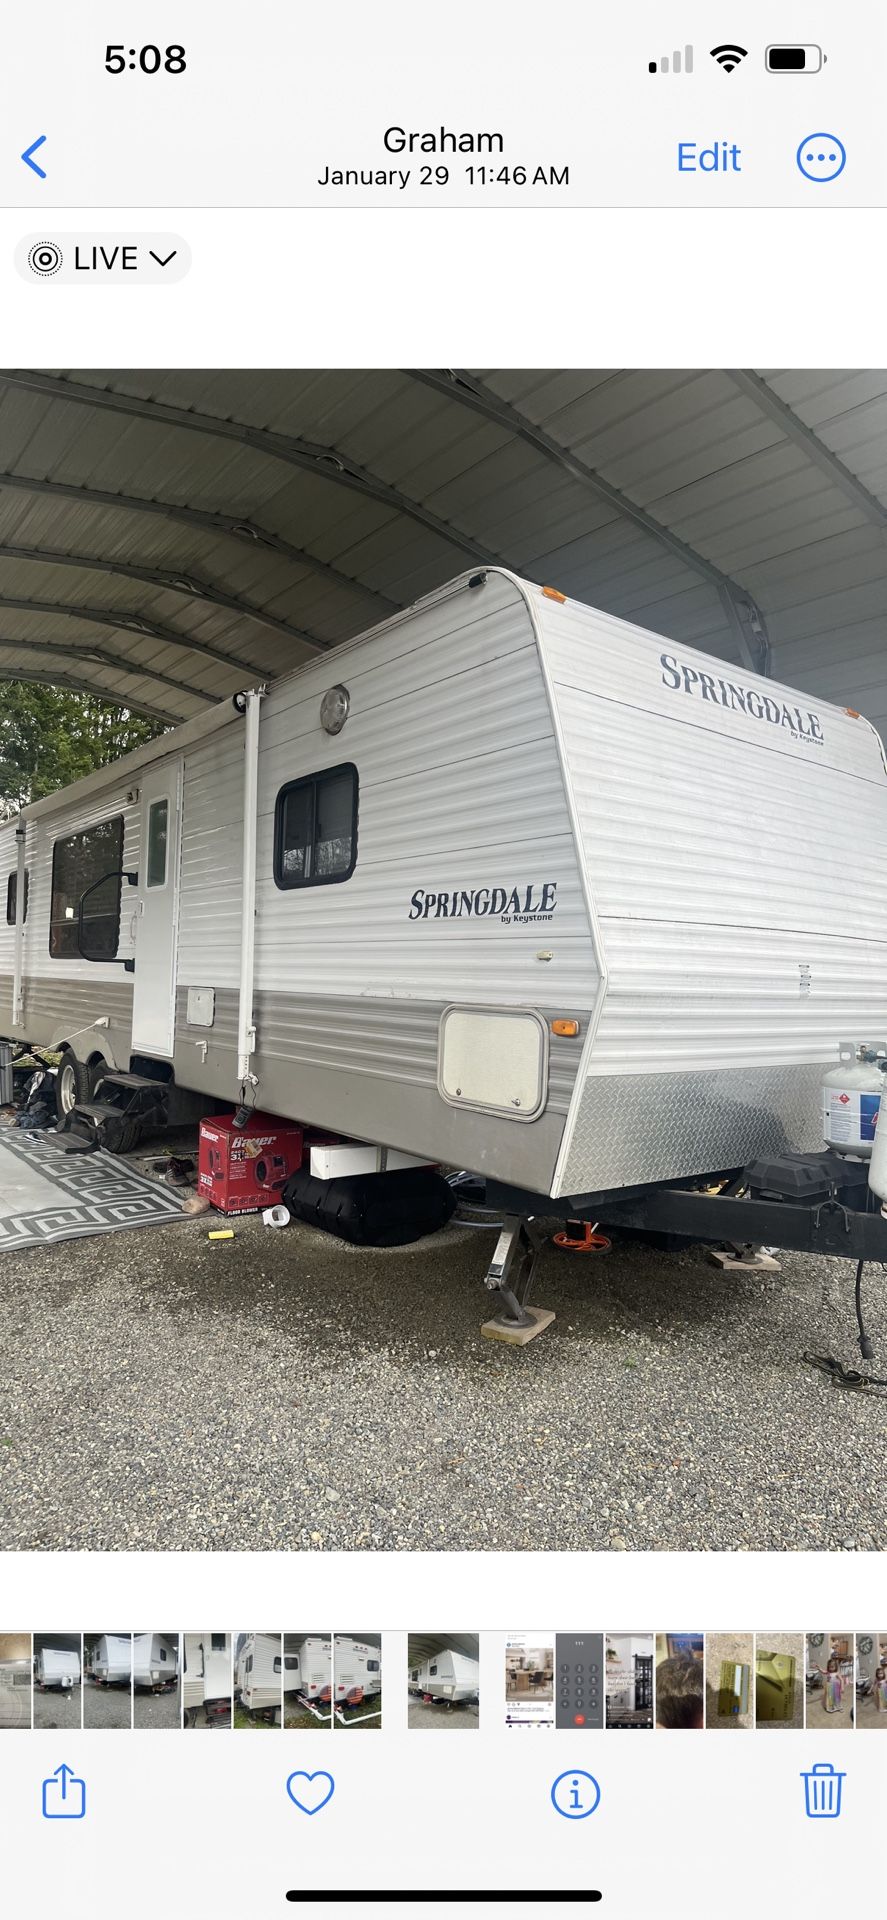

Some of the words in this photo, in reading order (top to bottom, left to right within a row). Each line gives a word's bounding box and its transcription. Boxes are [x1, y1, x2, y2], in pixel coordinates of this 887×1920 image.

[104, 44, 187, 75] 5:08
[383, 126, 504, 154] Graham
[677, 142, 742, 172] Edit
[317, 166, 411, 189] January
[419, 166, 450, 186] 29
[465, 166, 527, 186] 11:46
[531, 166, 569, 186] AM
[74, 245, 138, 271] LIVE
[790, 730, 799, 739] by
[501, 915, 511, 925] by
[513, 914, 553, 924] Keystone
